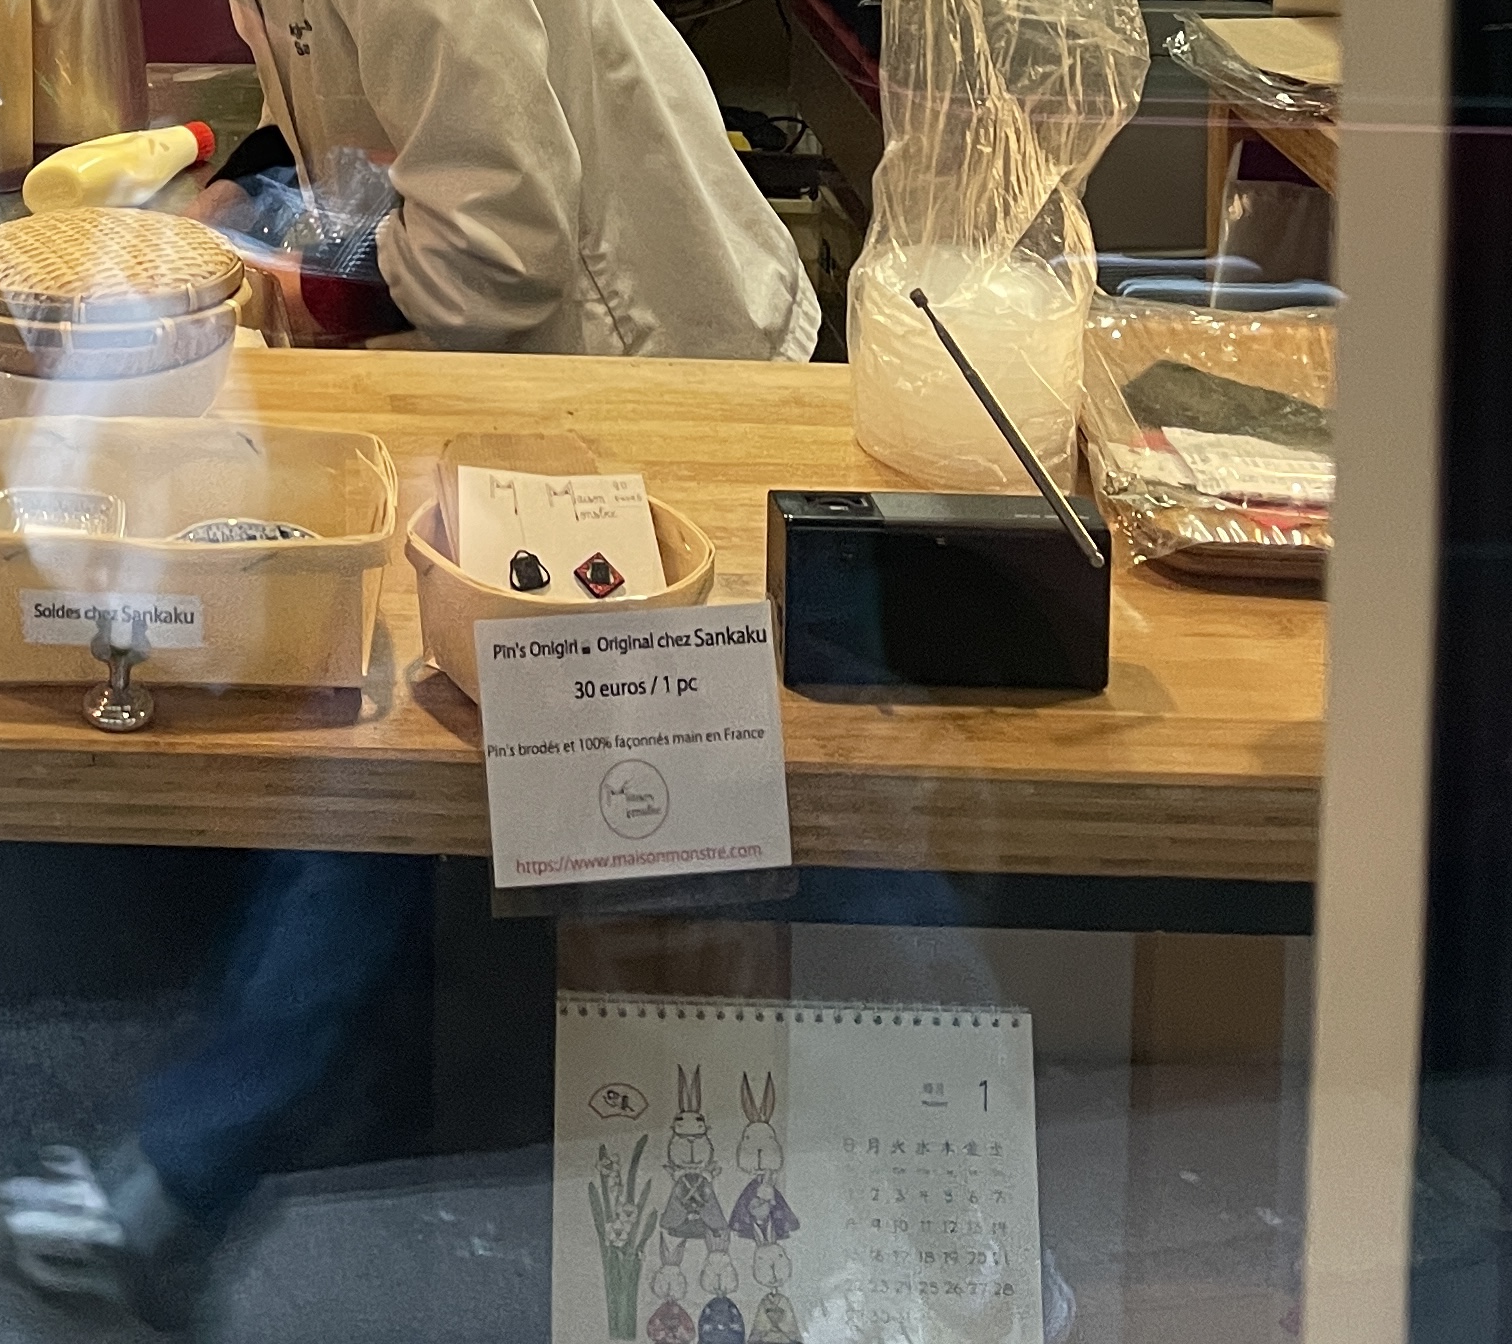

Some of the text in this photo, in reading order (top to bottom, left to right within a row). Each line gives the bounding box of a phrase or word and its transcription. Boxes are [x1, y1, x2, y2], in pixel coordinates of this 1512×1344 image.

[33, 603, 82, 620] Soldes
[121, 605, 195, 625] Sankaku
[493, 624, 768, 660] Pin's Onigiri Original chez Sankaku
[574, 674, 699, 700] 30 euros / 1 pc
[487, 726, 766, 758] Pin's brodés et 100% façonnés main en France
[979, 1079, 989, 1113] 1
